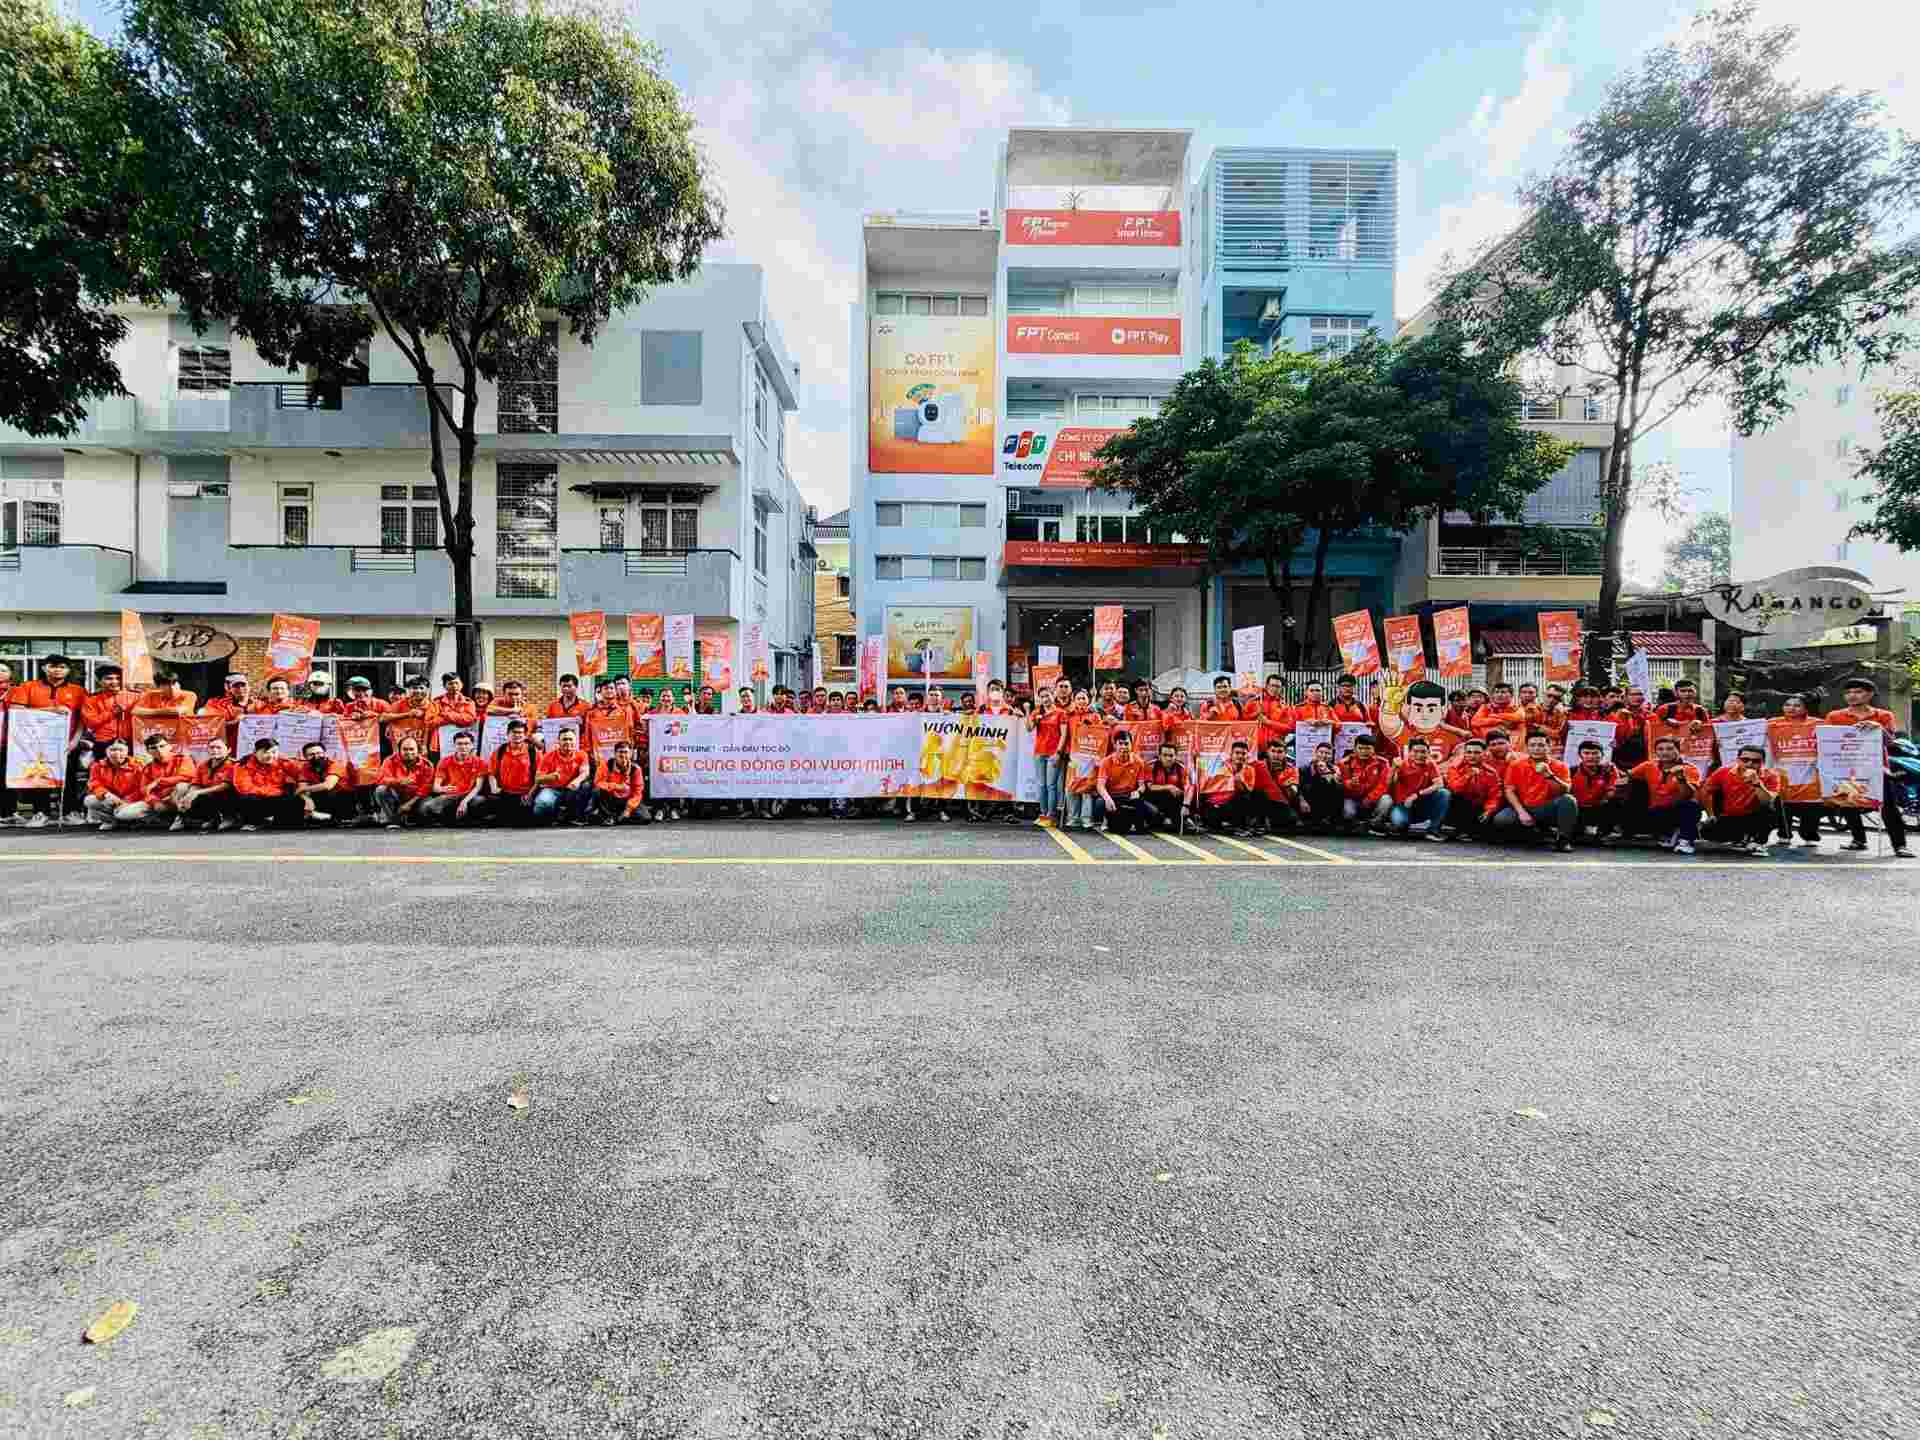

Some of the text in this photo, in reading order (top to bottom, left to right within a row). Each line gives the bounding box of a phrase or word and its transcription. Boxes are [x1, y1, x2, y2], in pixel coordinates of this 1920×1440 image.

[1124, 216, 1154, 228] FPT
[1016, 327, 1047, 341] FPT
[1003, 432, 1047, 458] FPT
[1003, 462, 1043, 473] Telecom
